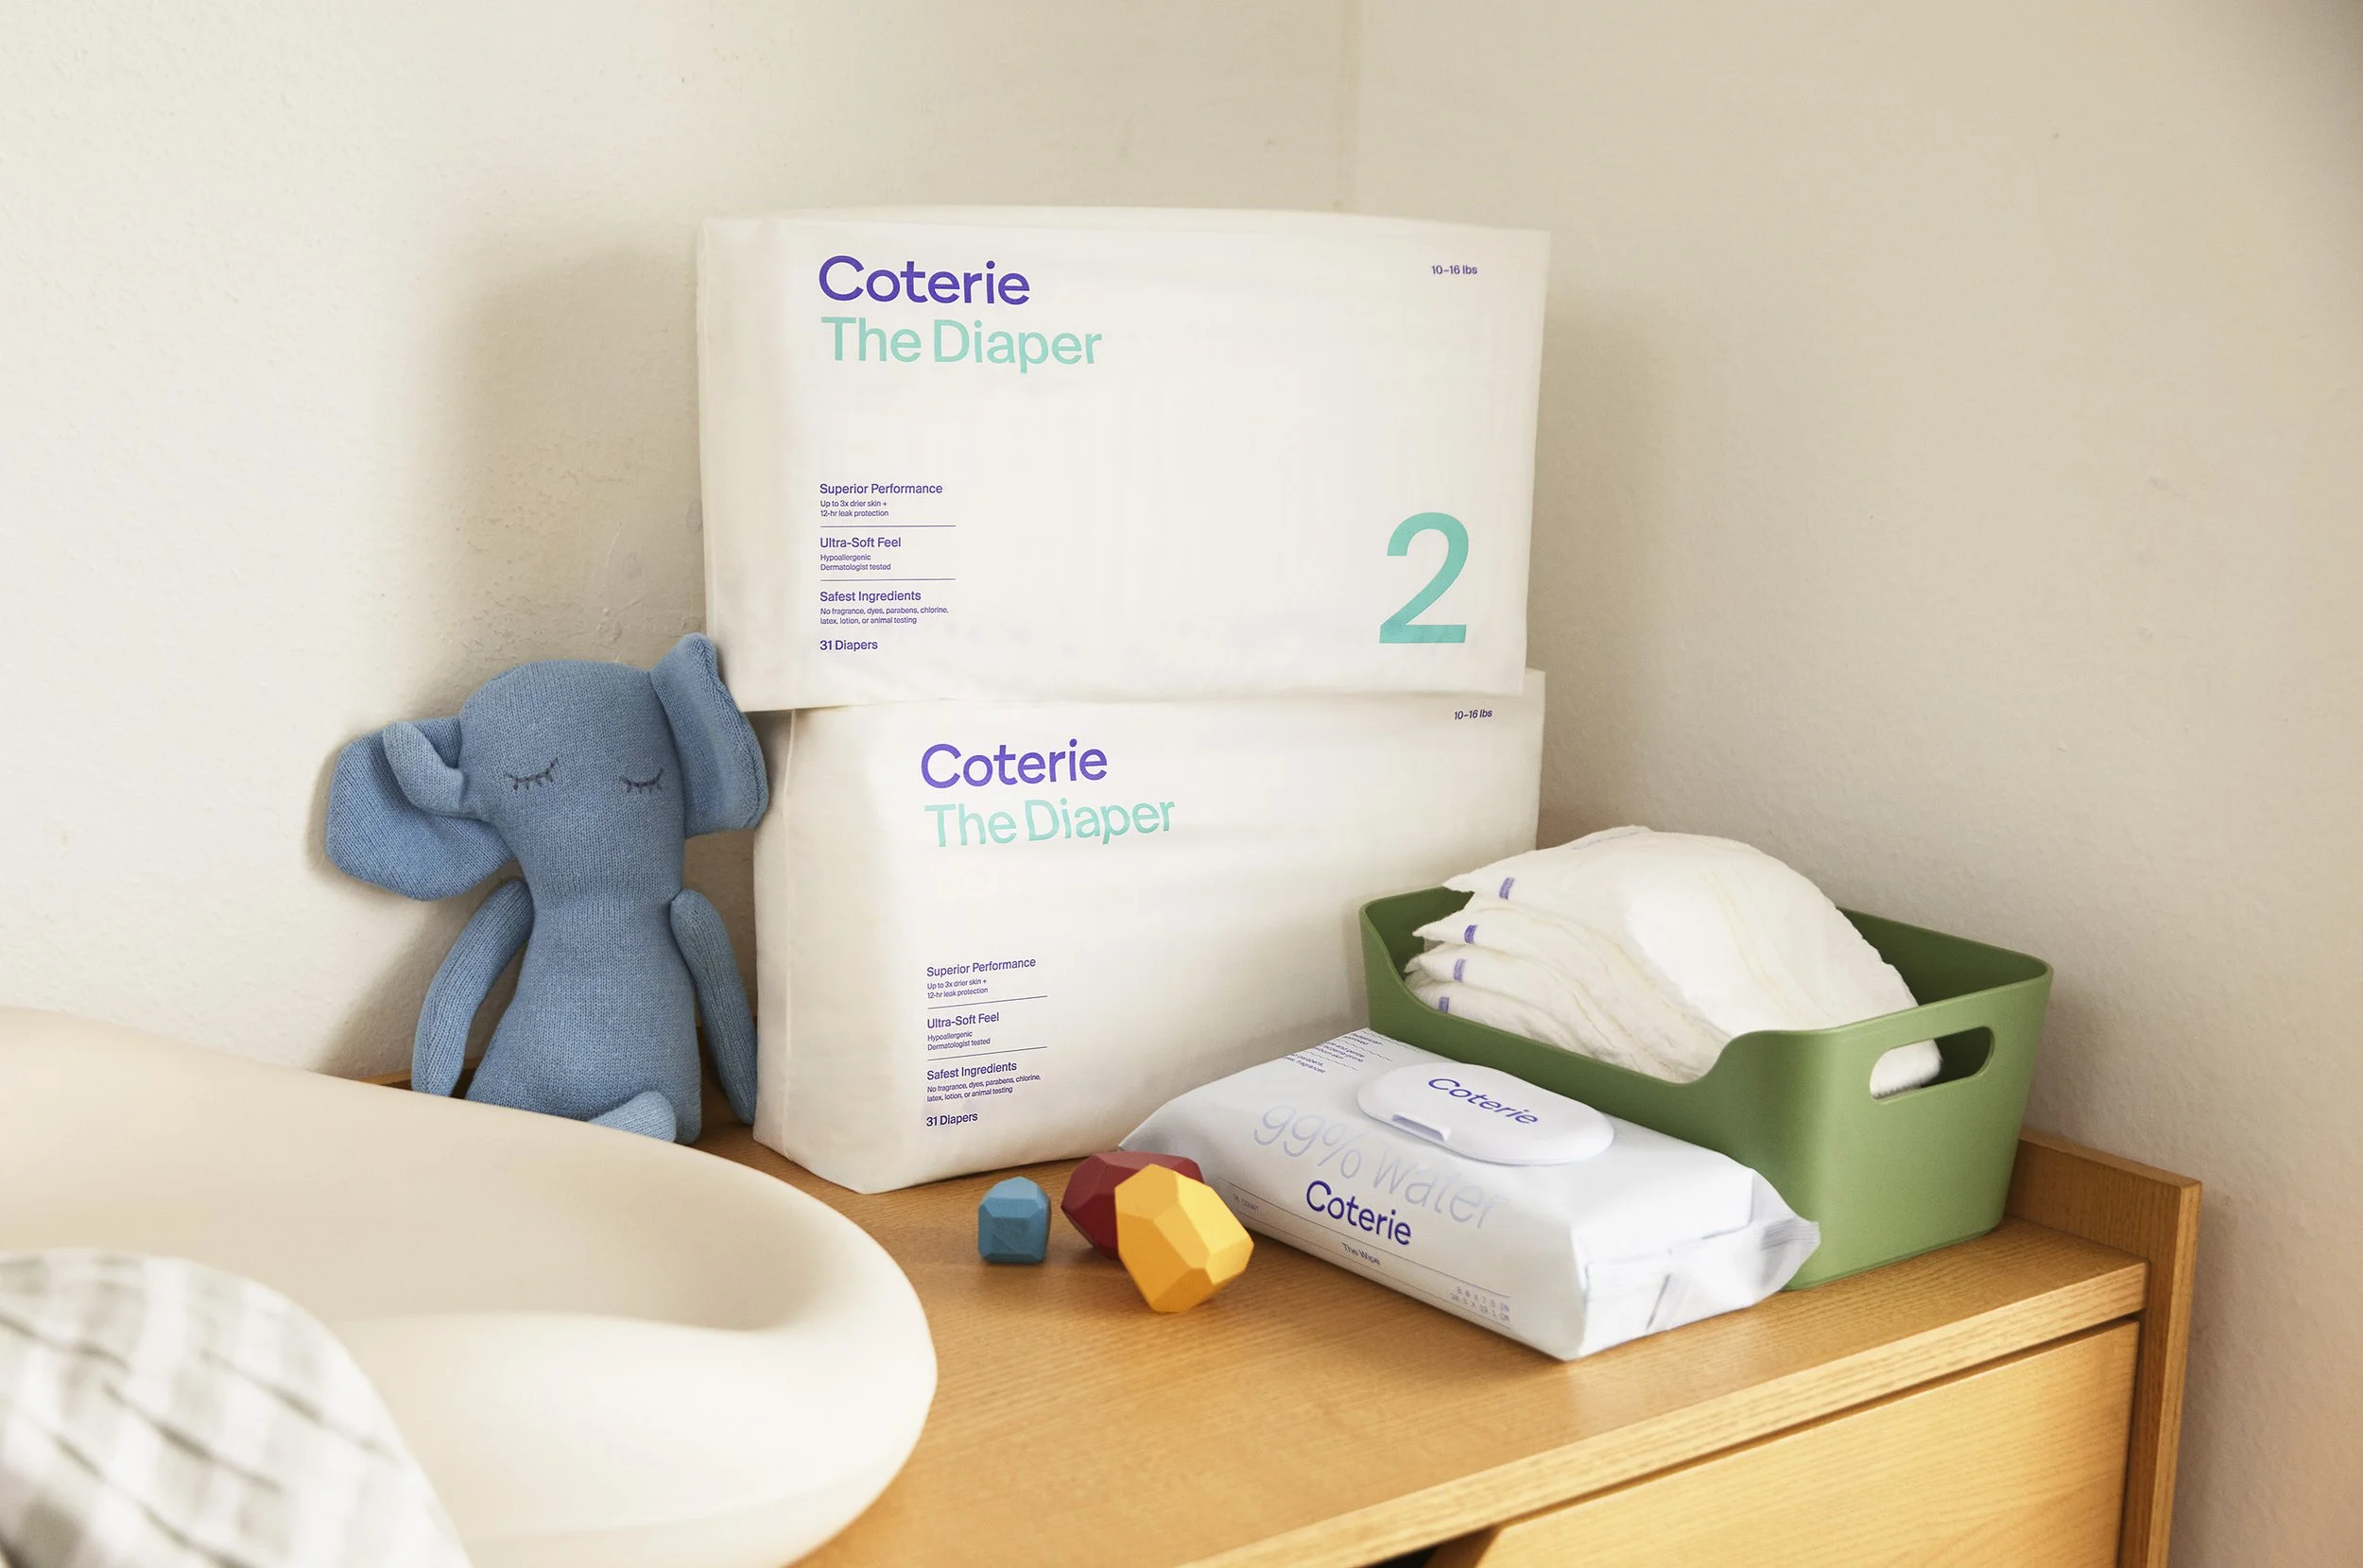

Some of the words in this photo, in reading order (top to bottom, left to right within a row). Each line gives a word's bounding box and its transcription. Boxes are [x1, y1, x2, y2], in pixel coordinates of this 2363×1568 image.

[1462, 265, 1478, 274] lbs
[819, 255, 1030, 305] Coterie
[820, 317, 923, 363] The
[934, 319, 1102, 374] Diaper
[820, 484, 869, 495] Superior
[871, 484, 942, 493] Performance
[820, 537, 874, 548] Ultra-Soft
[877, 537, 901, 547] Feel
[820, 563, 869, 572] Dermatologist
[1379, 512, 1469, 643] 2
[820, 591, 855, 601] Safest
[858, 591, 922, 603] Ingredients
[819, 640, 833, 650] 31
[836, 640, 878, 651] Diapers
[1480, 709, 1492, 718] lbs
[922, 738, 1107, 788] Coterie
[923, 803, 1017, 847] The
[1025, 798, 1175, 844] Diaper
[926, 964, 970, 977] Superior
[973, 958, 1036, 973] Performance
[957, 988, 988, 997] protection
[927, 1015, 975, 1028] Ultra-Soft
[978, 1012, 999, 1024] Feel
[927, 1031, 973, 1042] Hypoallergenic
[927, 1041, 970, 1051] Dermatologist
[972, 1038, 991, 1046] tested
[926, 1068, 959, 1080] Safest
[962, 1061, 1017, 1077] Ingredients
[972, 1089, 992, 1097] animal
[992, 1087, 1013, 1095] testing
[1428, 1078, 1539, 1124] Coterie
[926, 1116, 937, 1127] 31
[940, 1112, 977, 1125] Diapers
[1253, 1106, 1370, 1179] 99%
[1306, 1180, 1411, 1246] Coterie
[1341, 1242, 1359, 1255] The
[1358, 1249, 1381, 1266] Wipe
